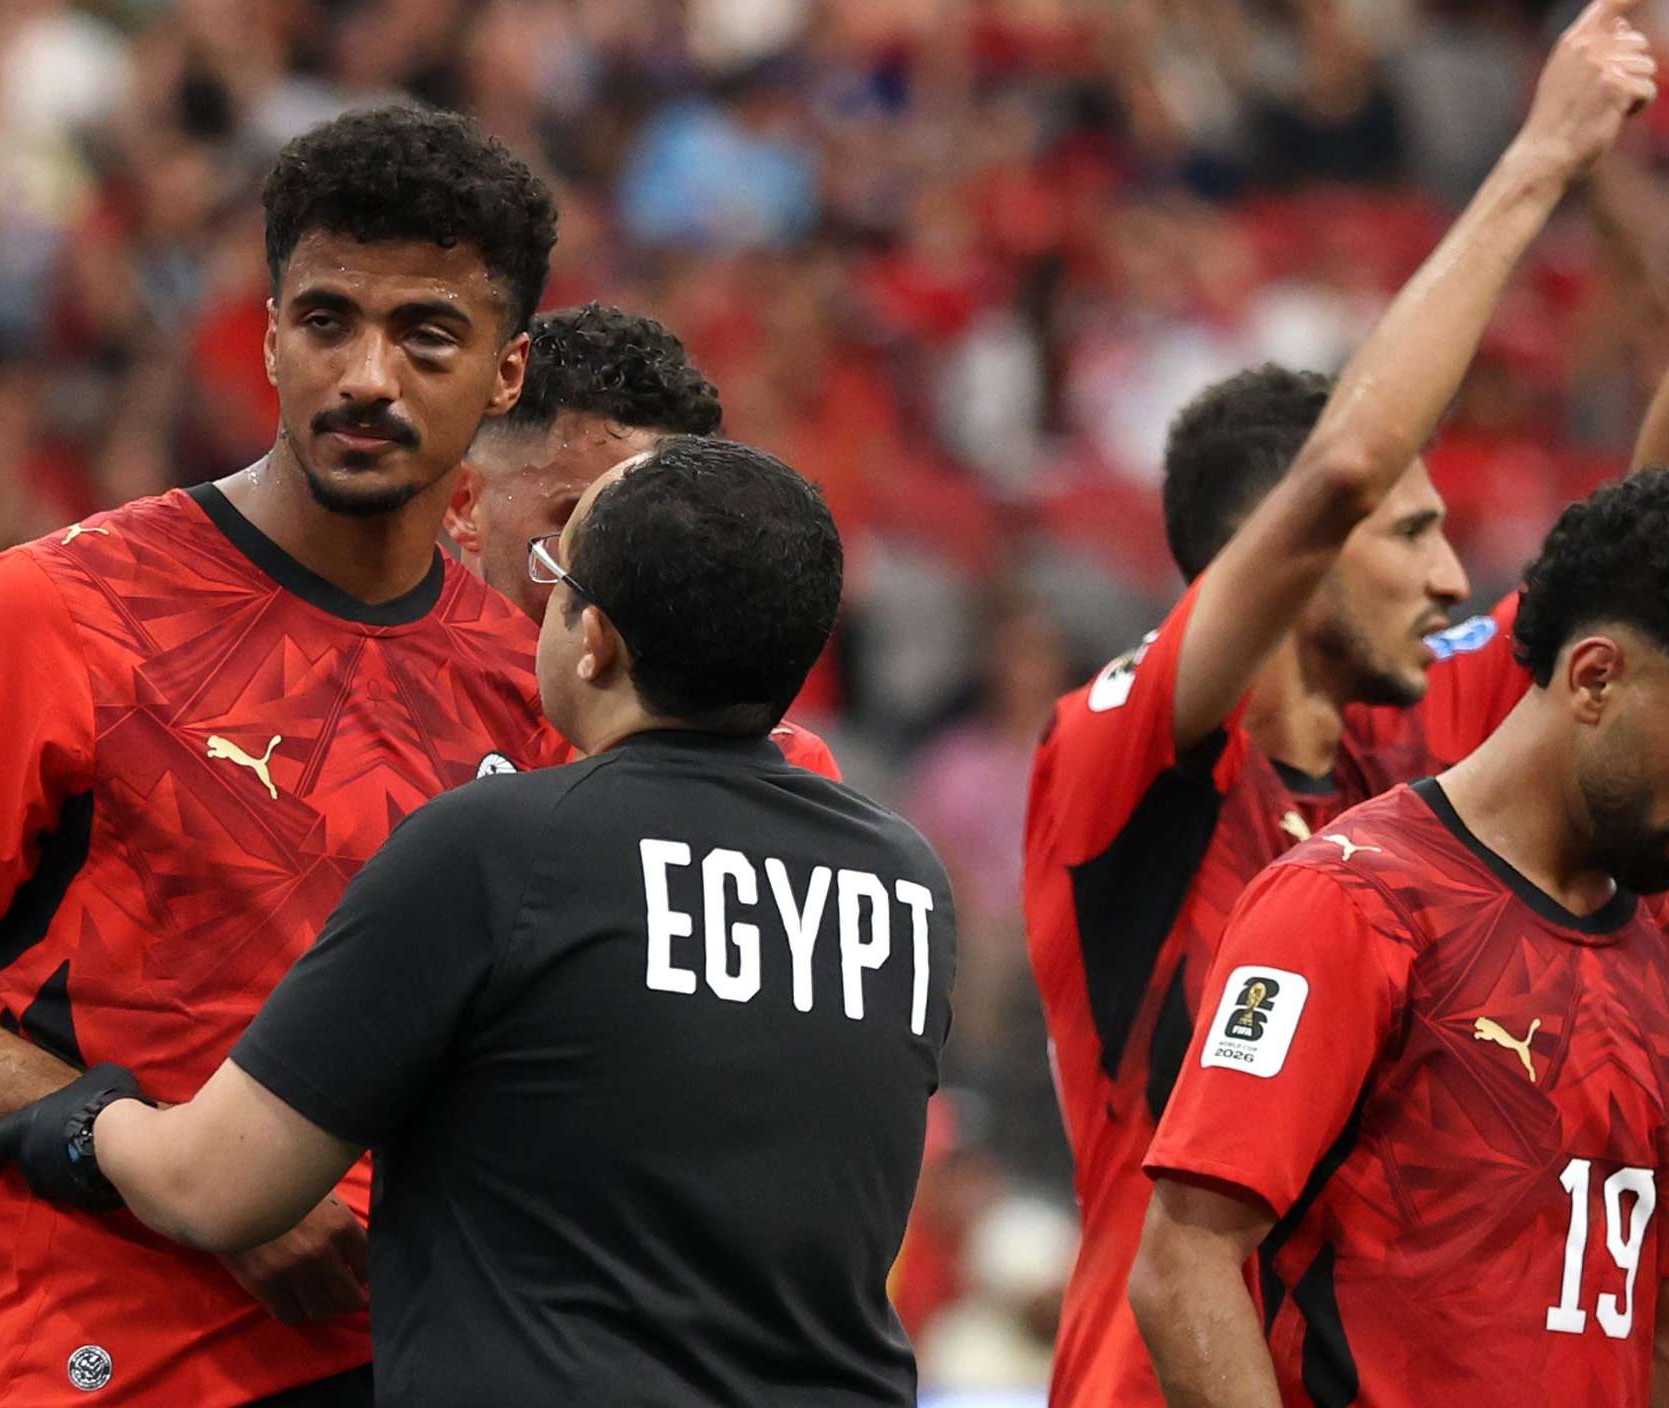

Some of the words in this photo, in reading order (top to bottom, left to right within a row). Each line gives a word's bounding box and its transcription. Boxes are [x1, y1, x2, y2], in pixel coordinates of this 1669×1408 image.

[639, 838, 934, 1036] EGYPT
[1213, 1048, 1254, 1063] 2026
[1545, 1158, 1656, 1340] 19
